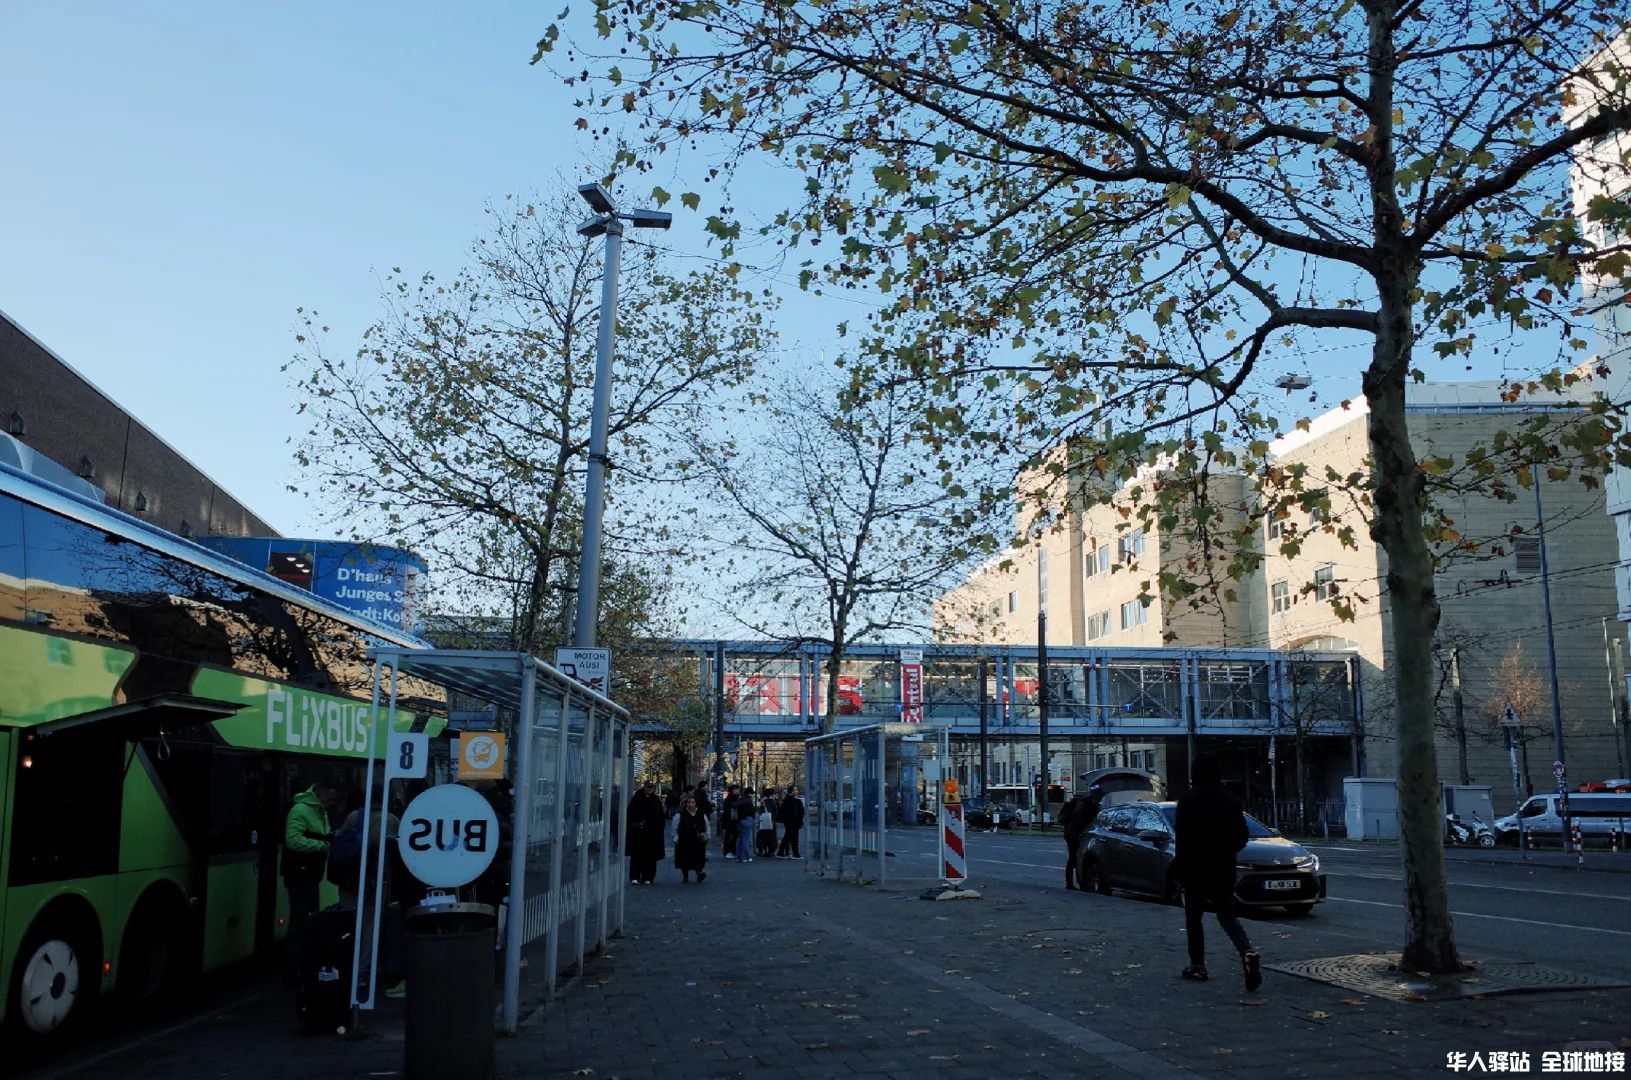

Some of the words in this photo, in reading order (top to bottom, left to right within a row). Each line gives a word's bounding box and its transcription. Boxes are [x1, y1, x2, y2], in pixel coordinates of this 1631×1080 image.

[336, 585, 391, 602] Junges
[575, 652, 606, 660] MOTOR
[400, 741, 414, 769] 8
